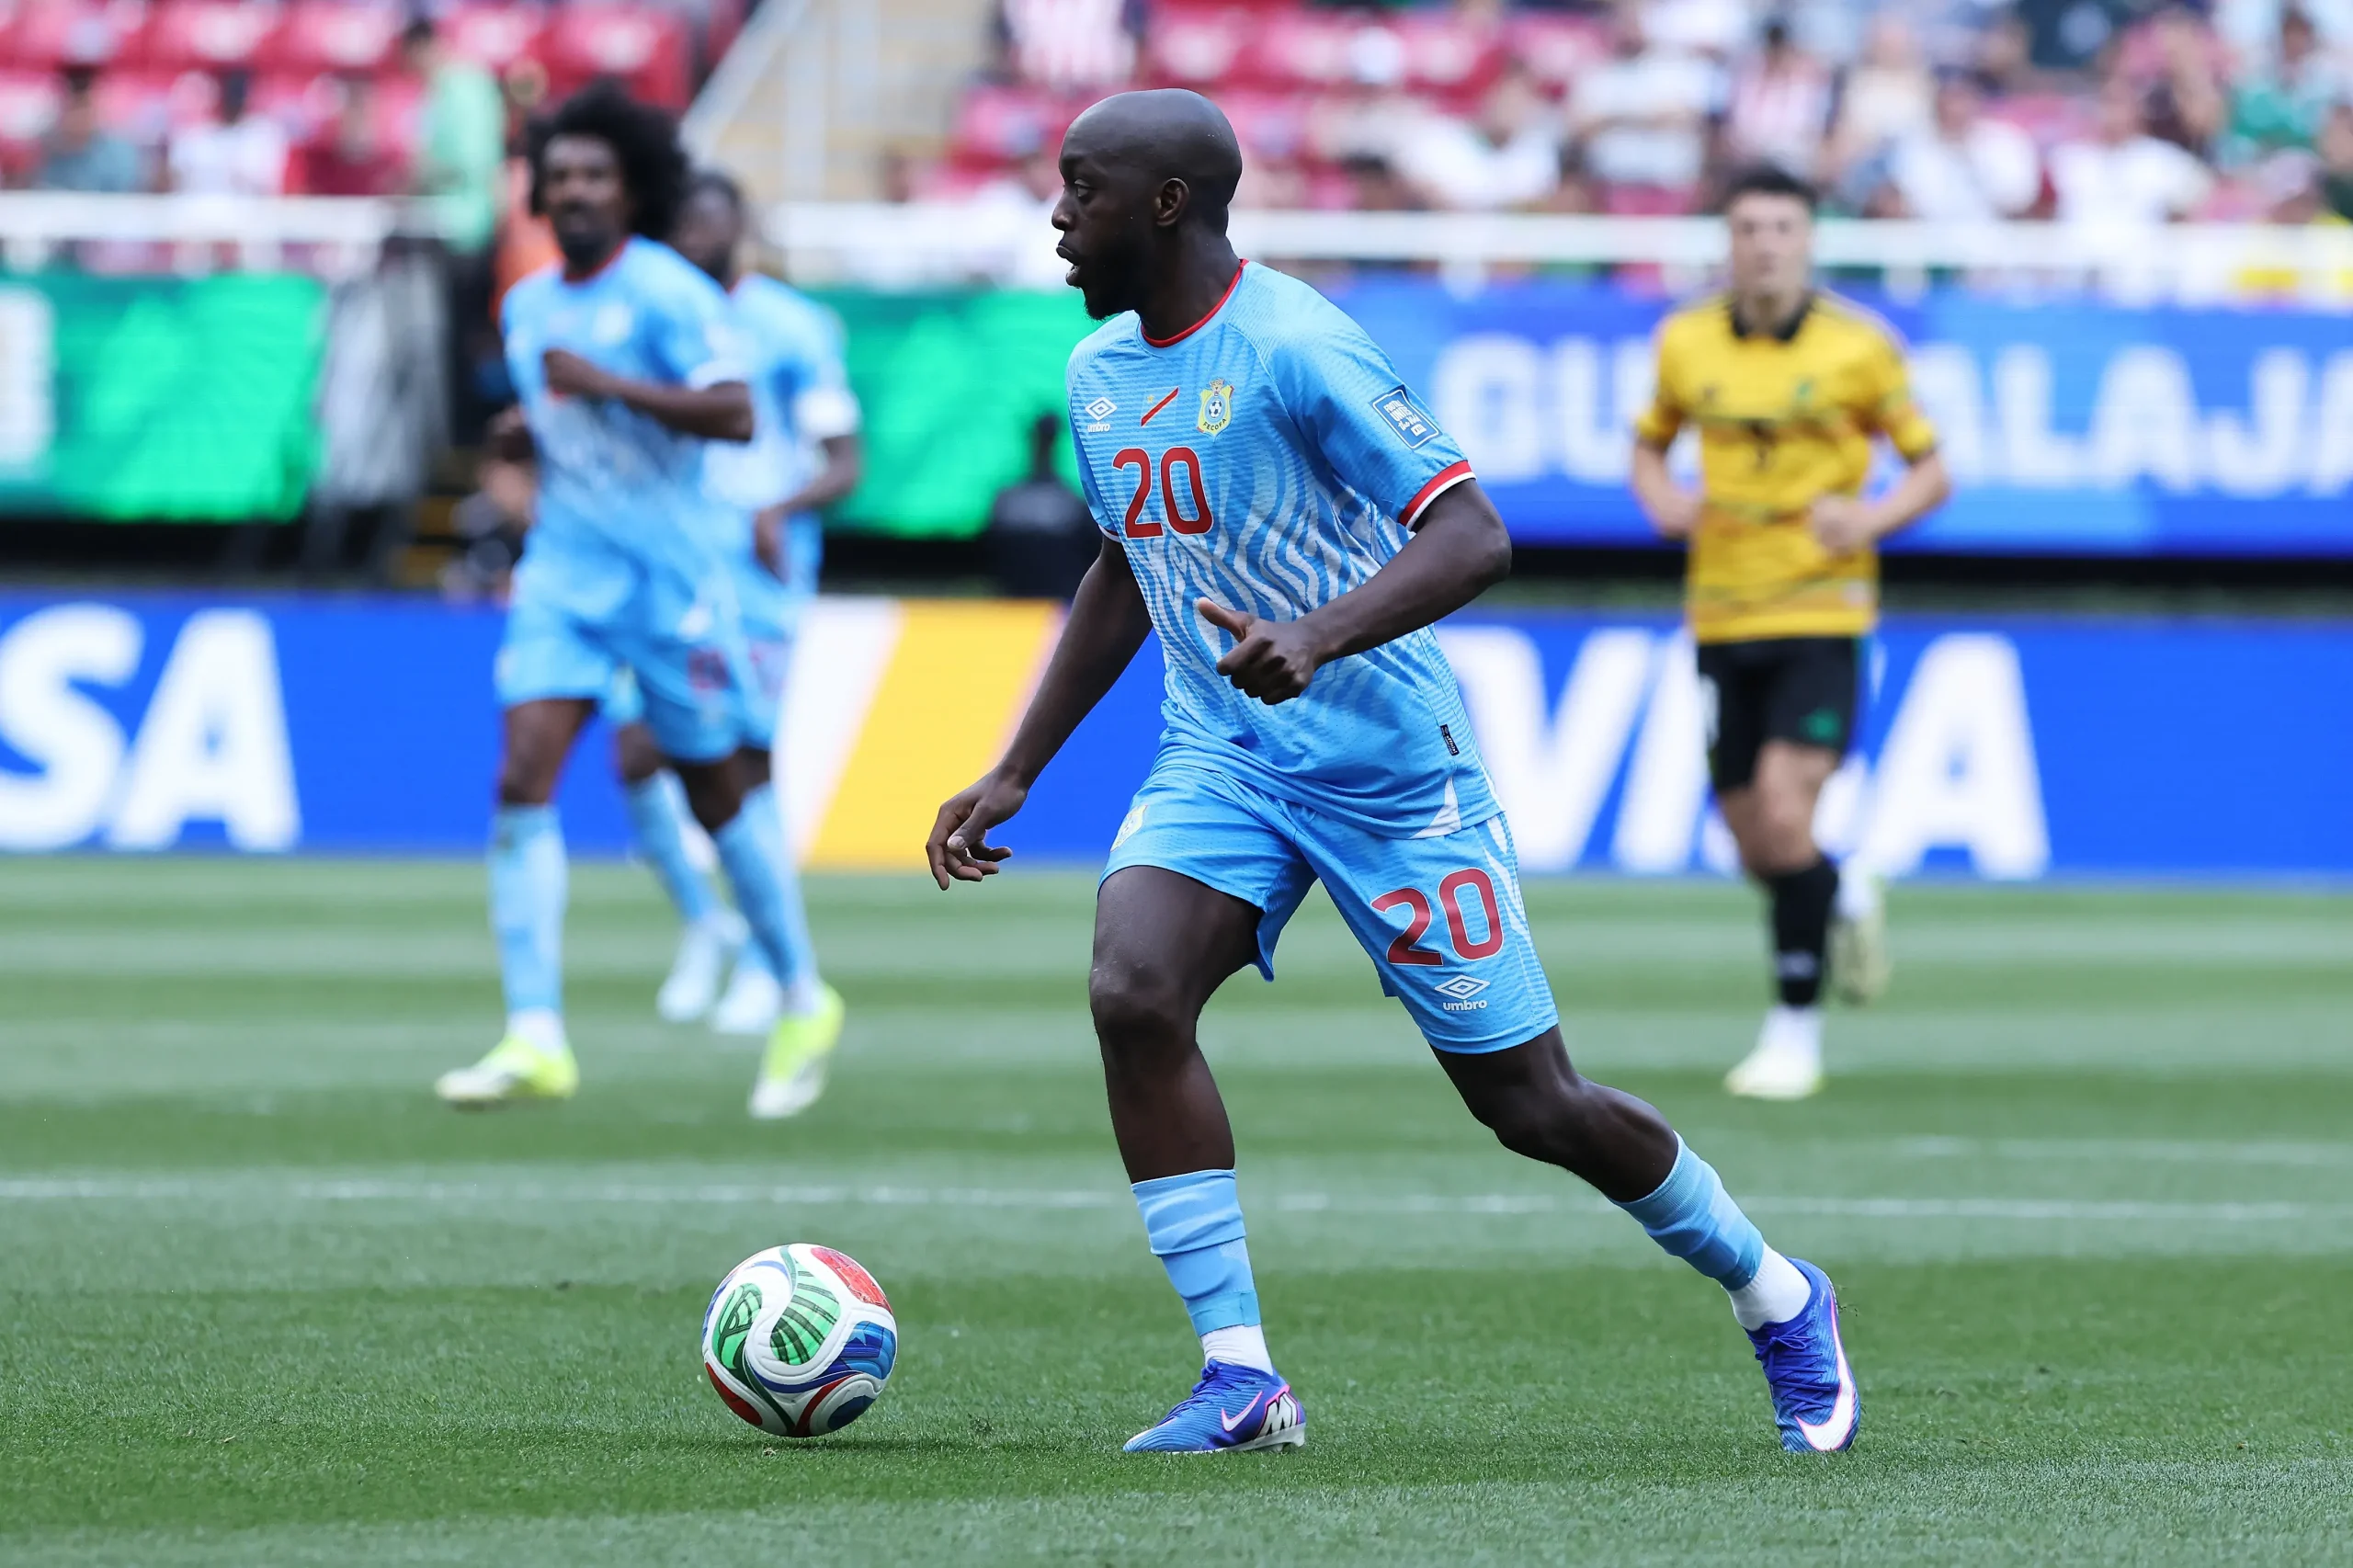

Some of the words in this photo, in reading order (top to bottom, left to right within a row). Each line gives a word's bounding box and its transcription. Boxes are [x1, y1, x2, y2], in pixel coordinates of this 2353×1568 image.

[1087, 422, 1110, 432] umbro
[1203, 418, 1226, 431] FECOFA
[1437, 333, 2353, 496] GUALAJ
[1113, 447, 1213, 539] 20
[1370, 868, 1504, 966] 20
[1443, 999, 1488, 1011] umbro
